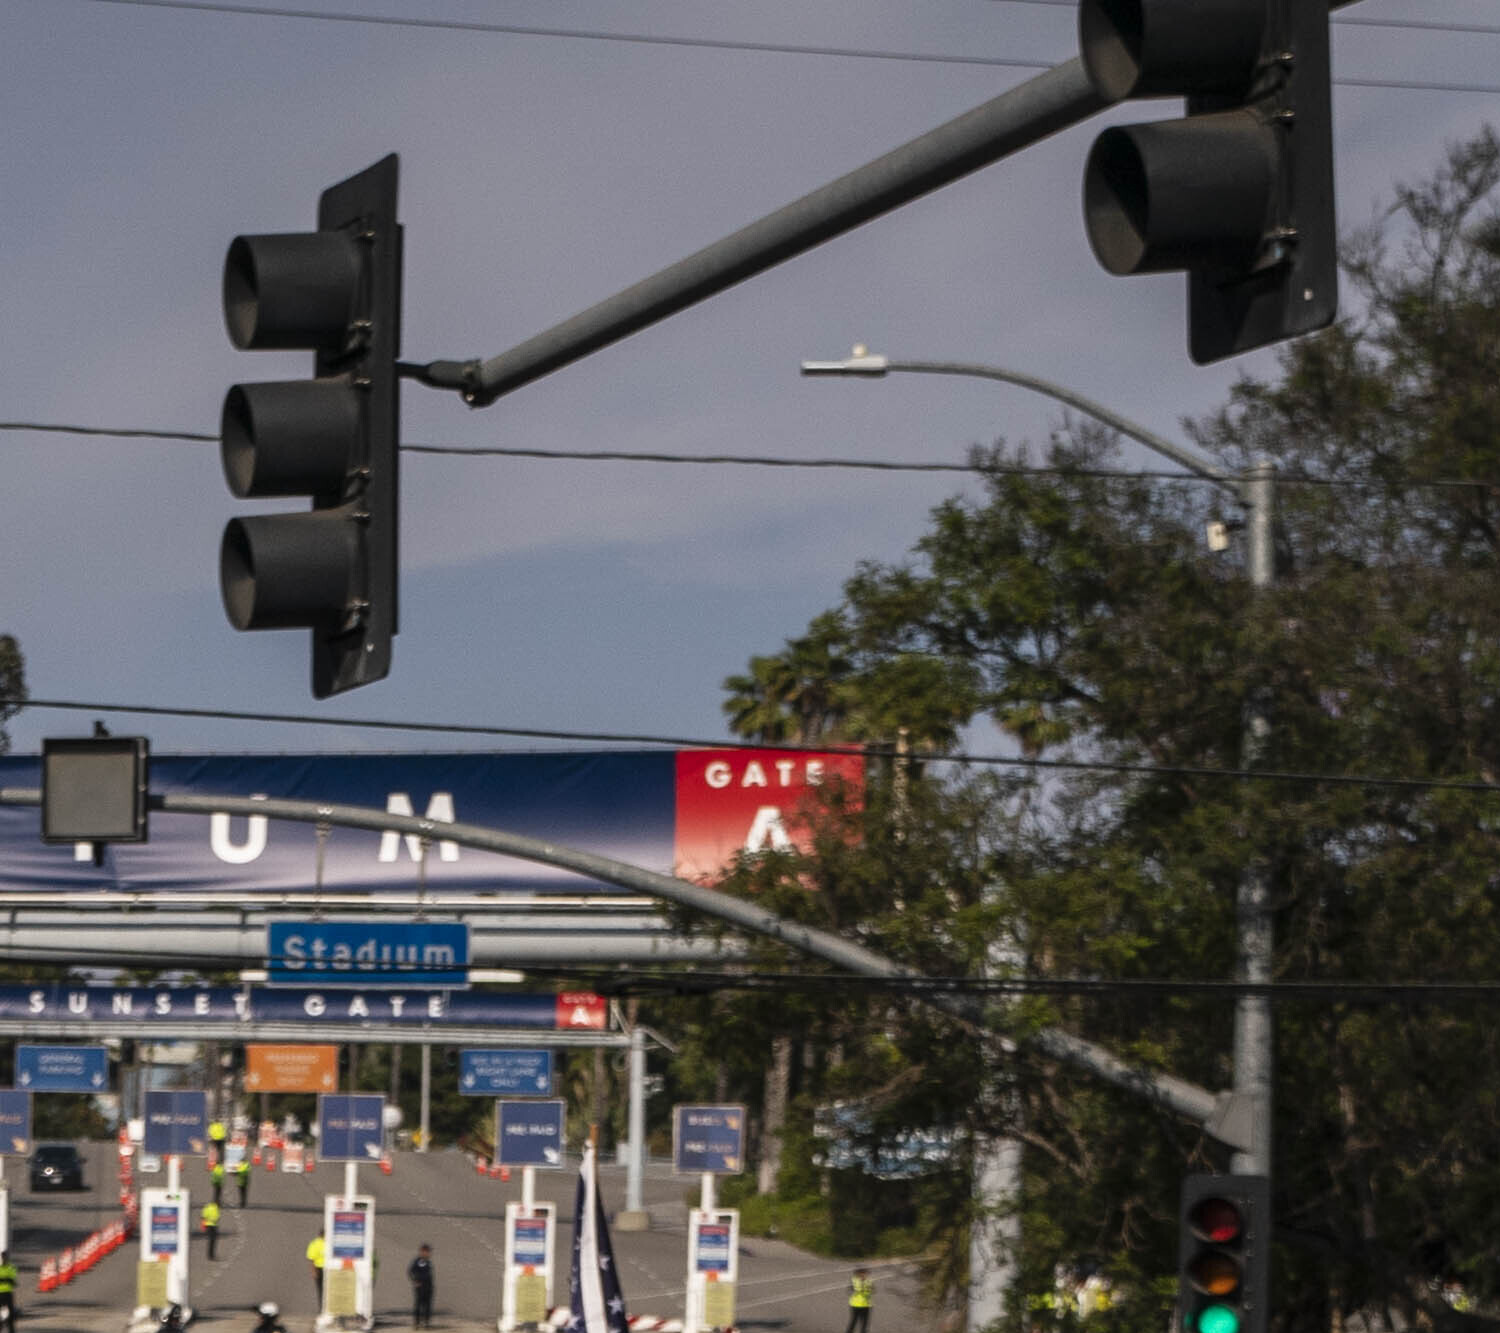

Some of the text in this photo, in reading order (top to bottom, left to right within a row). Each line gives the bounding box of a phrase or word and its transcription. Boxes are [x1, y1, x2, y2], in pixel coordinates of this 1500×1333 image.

[705, 759, 823, 789] GATE
[282, 933, 457, 974] Stadium
[28, 991, 447, 1019] SUNSET GATE
[567, 1005, 592, 1025] A
